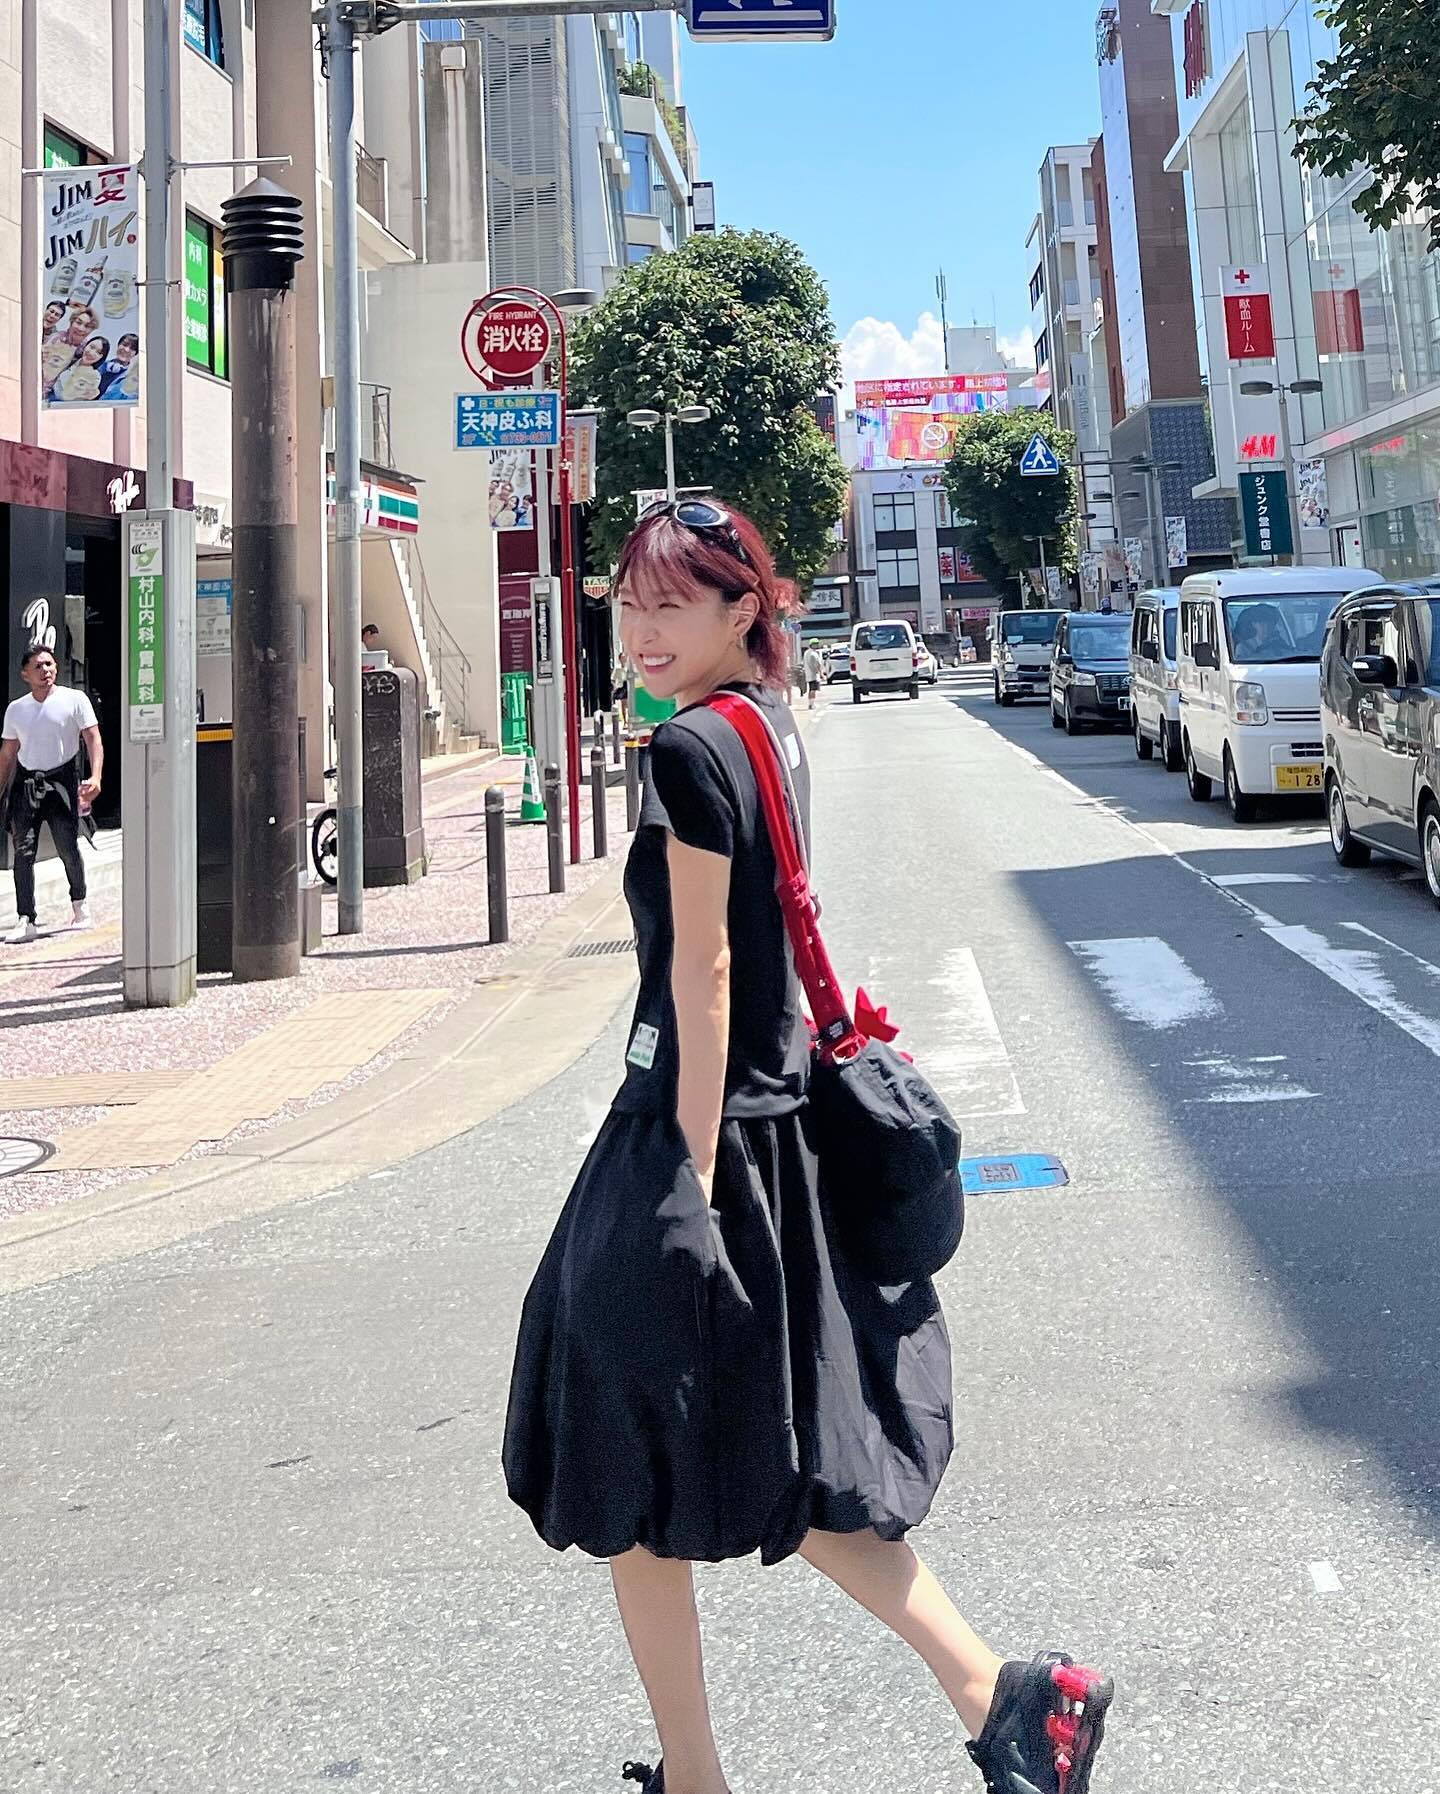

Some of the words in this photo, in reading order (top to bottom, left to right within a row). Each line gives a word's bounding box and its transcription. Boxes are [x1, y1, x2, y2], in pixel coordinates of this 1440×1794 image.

[51, 180, 93, 218] JIM
[488, 311, 505, 321] FIRE
[505, 310, 538, 320] HYDRANT
[483, 323, 545, 353] 消火栓
[462, 410, 552, 432] 天神皮ふ科
[1255, 475, 1272, 551] ジュンク堂書店
